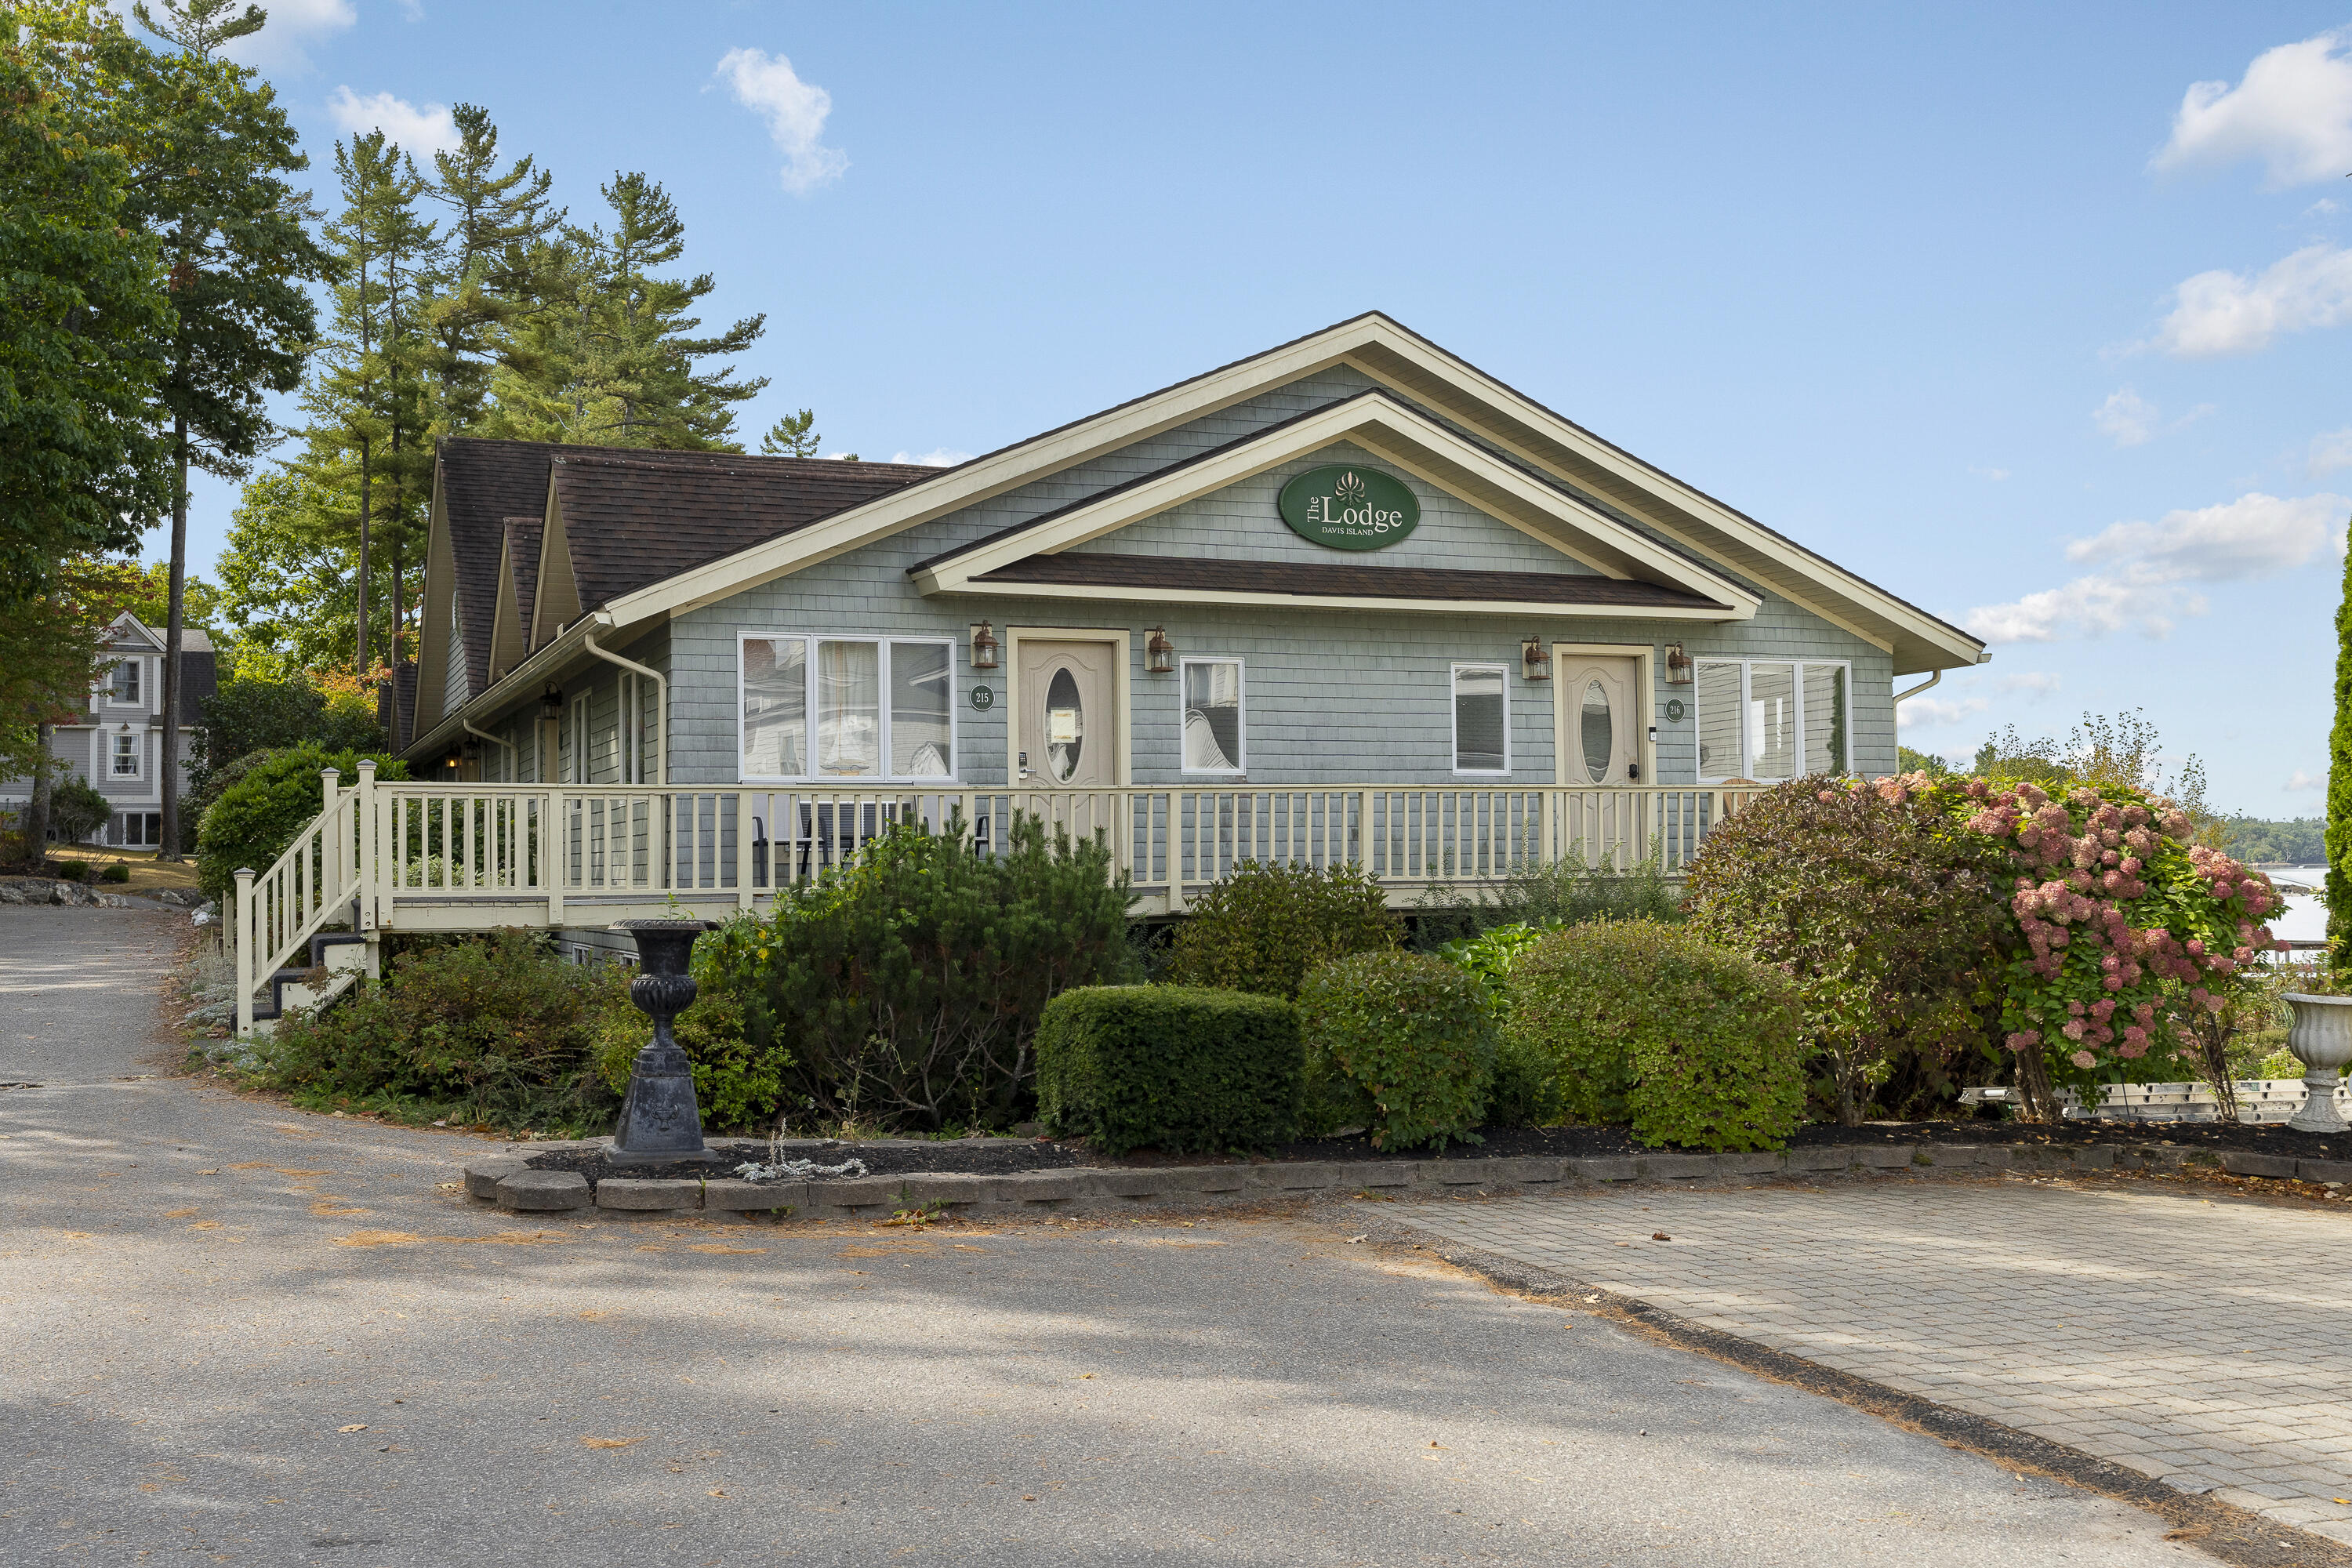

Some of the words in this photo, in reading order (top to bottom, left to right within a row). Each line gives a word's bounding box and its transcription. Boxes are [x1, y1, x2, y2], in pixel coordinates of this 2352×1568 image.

[1307, 496, 1319, 522] The
[1320, 495, 1403, 533] Lodge
[976, 692, 989, 702] 215
[1670, 706, 1680, 714] 216
